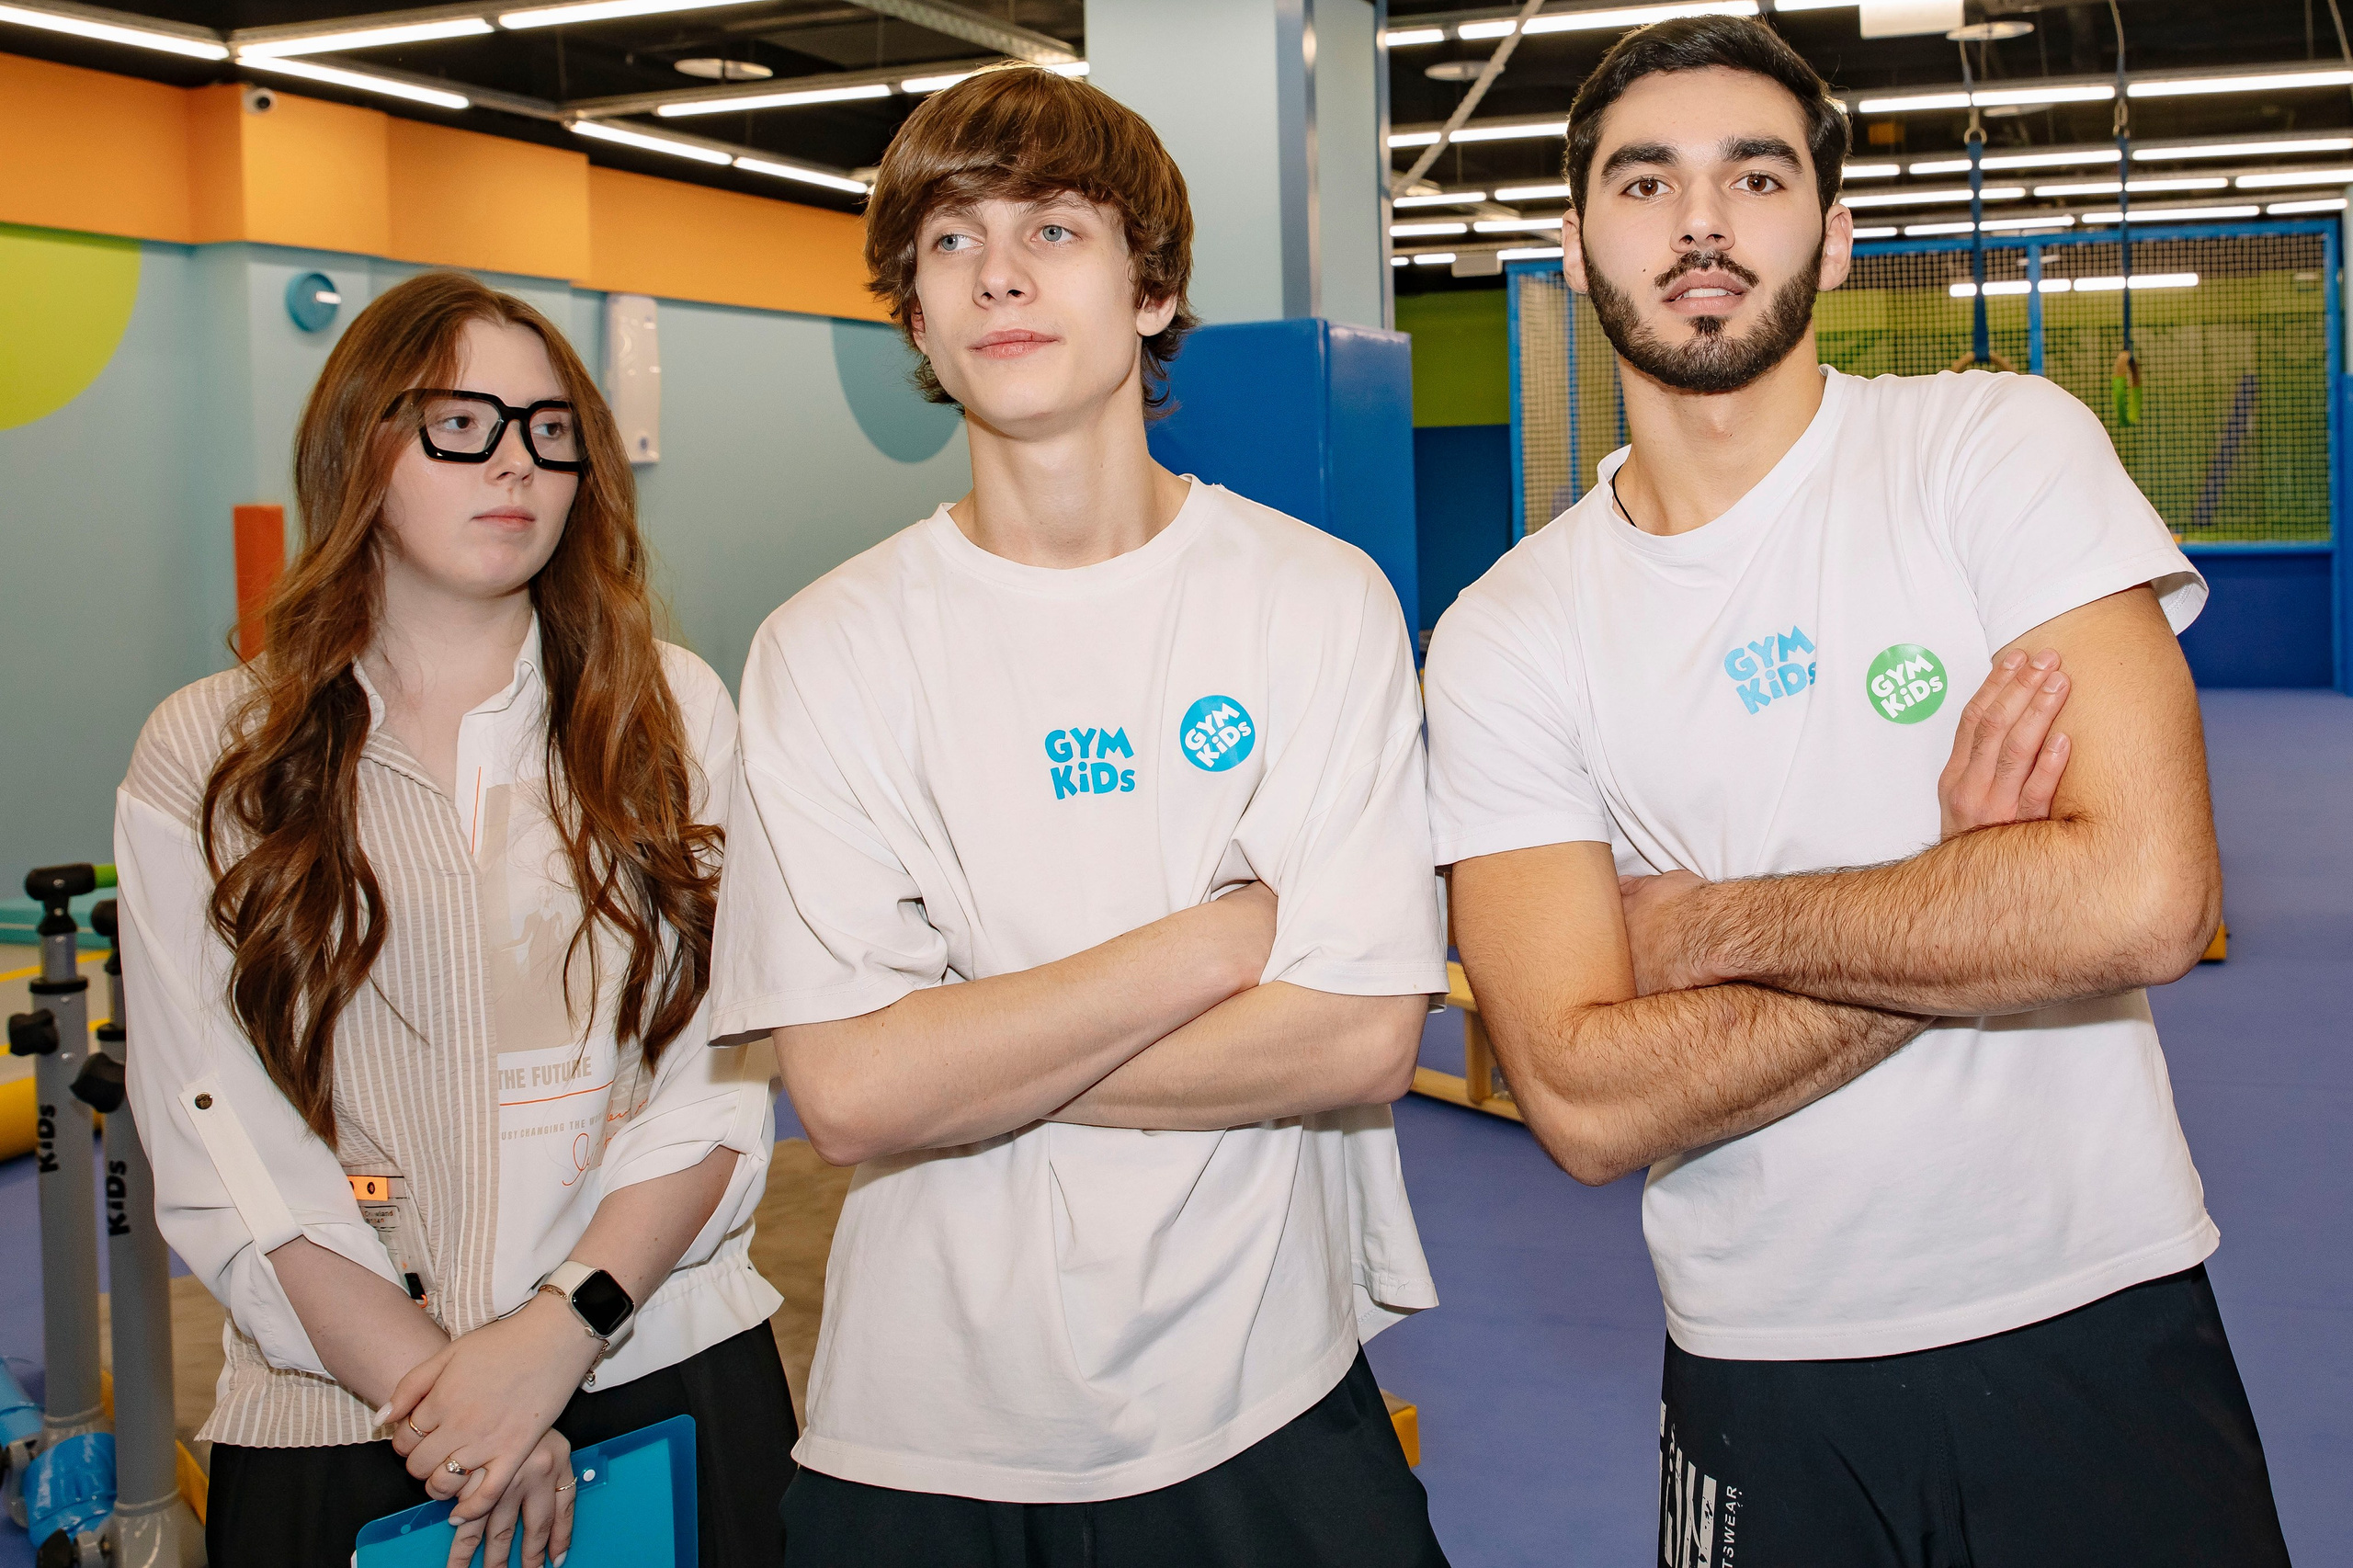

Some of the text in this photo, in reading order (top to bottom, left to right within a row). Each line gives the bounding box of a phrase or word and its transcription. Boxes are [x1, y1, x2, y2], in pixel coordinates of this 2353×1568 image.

[1723, 625, 1815, 681] GYM
[1870, 653, 1935, 698] GYM
[1880, 676, 1944, 719] KiDs
[1044, 726, 1135, 763] GYM
[1184, 702, 1241, 751] GYM
[1196, 721, 1252, 768] KiDs
[1050, 760, 1136, 800] KiDs
[498, 1055, 592, 1090] THE FUTURE
[519, 1122, 564, 1138] CHANGING
[569, 1119, 585, 1131] THE
